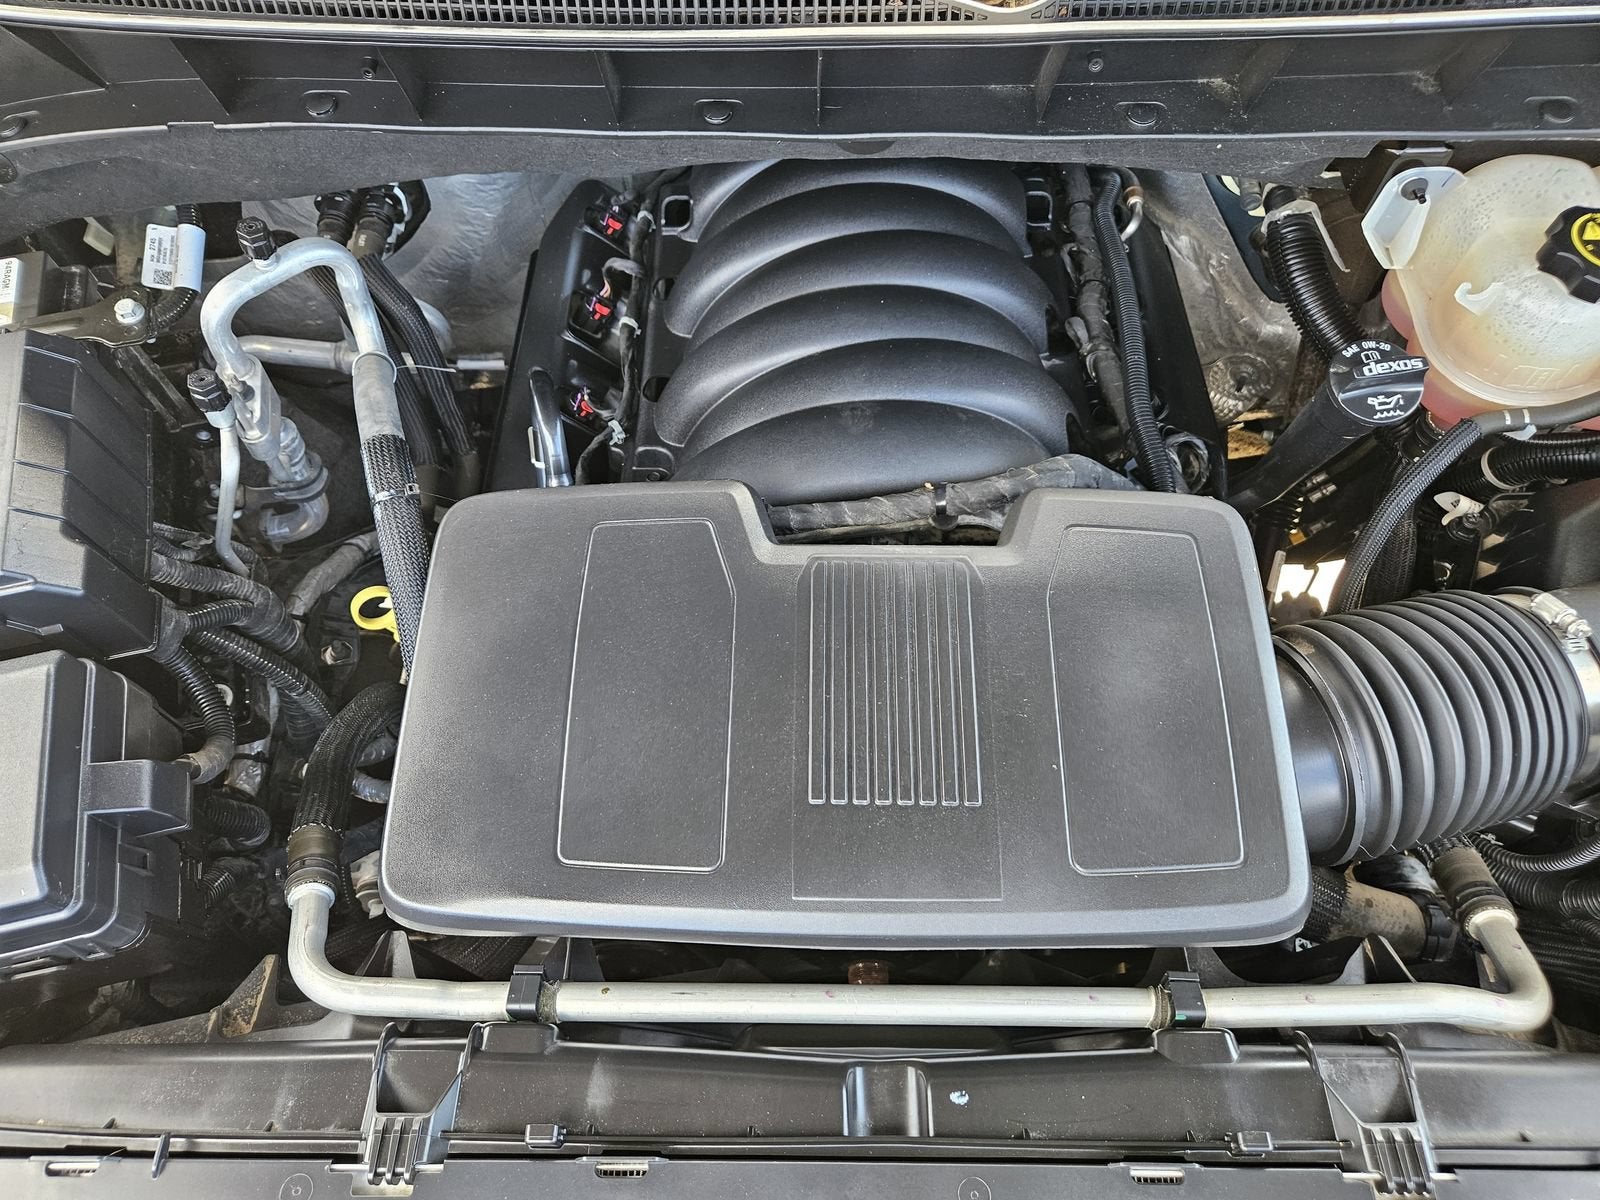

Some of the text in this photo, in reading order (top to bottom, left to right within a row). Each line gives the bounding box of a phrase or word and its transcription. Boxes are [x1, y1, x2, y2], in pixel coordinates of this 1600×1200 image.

[1342, 341, 1391, 357] SAE 0W-20
[1363, 358, 1423, 376] dexos
